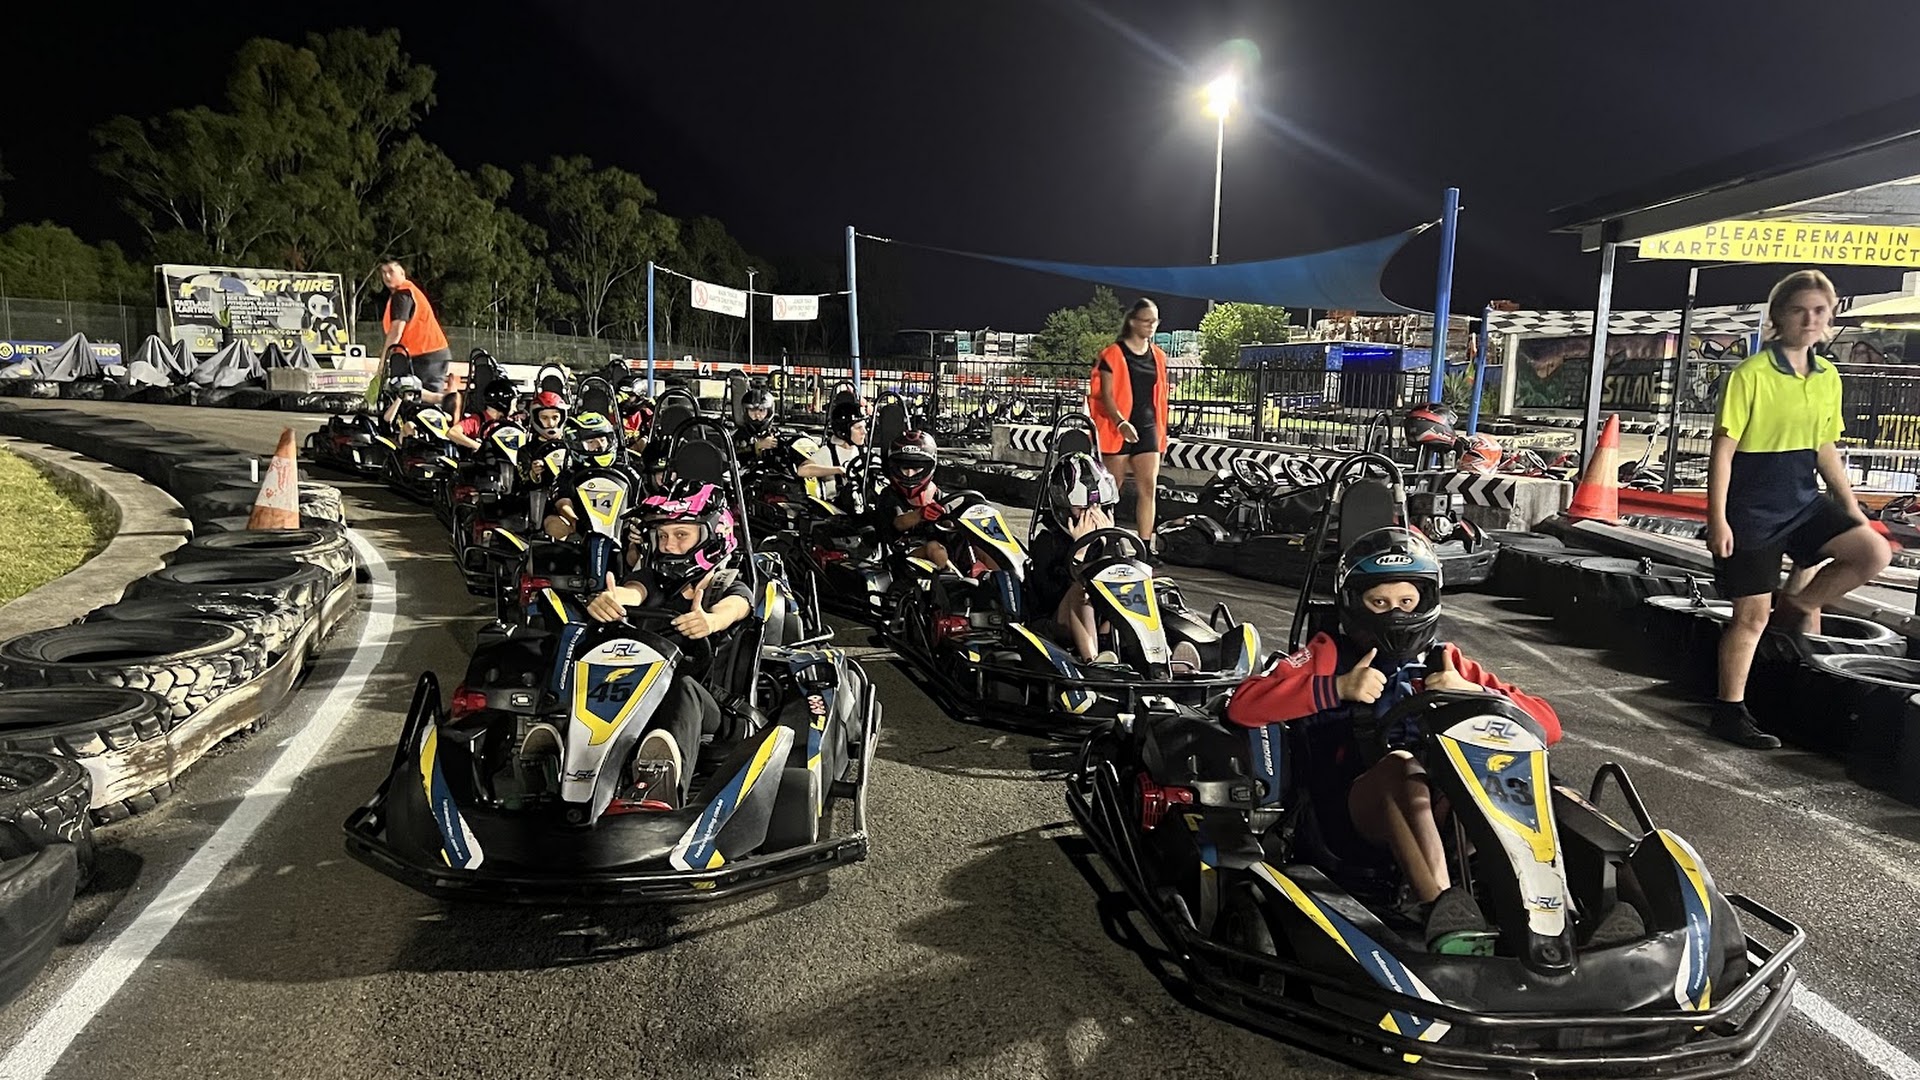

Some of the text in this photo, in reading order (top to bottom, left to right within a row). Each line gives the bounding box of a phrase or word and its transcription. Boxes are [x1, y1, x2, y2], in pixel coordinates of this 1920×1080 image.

[1705, 225, 1909, 246] PLEASE REMAIN IN
[1658, 240, 1920, 262] KARTS UNTIL INSTRUCT
[292, 280, 334, 292] HIRE
[175, 306, 214, 315] KARTING
[196, 338, 215, 347] 02
[15, 344, 54, 355] METRO
[701, 364, 710, 377] 4
[1601, 375, 1673, 404] STLANE
[589, 498, 612, 509] 14
[1379, 556, 1411, 565] HJC
[1116, 593, 1147, 607] 54
[602, 643, 641, 656] JRL
[588, 682, 632, 703] 45
[1472, 720, 1517, 740] JRL
[1485, 775, 1535, 806] 43
[1528, 896, 1562, 909] JRL
